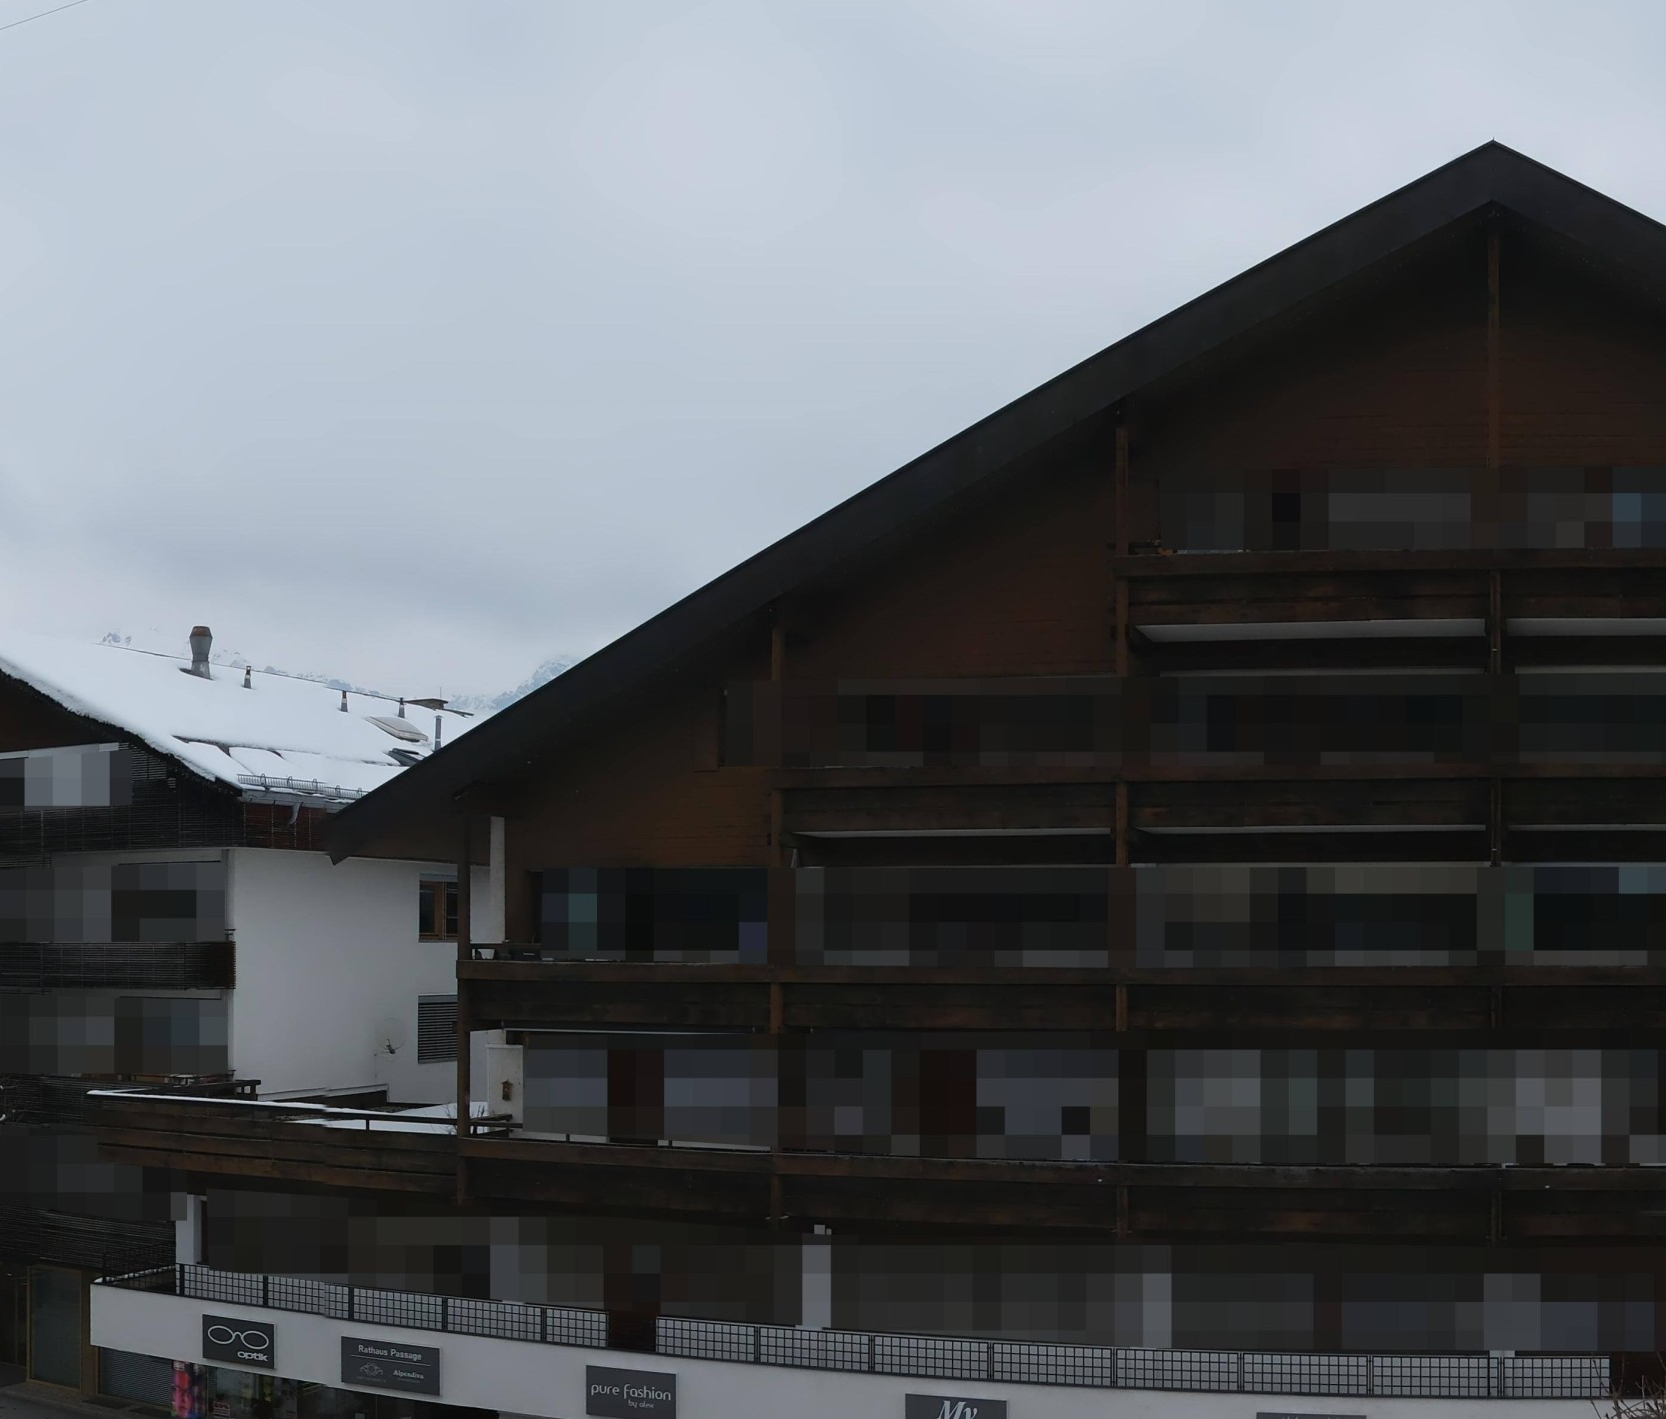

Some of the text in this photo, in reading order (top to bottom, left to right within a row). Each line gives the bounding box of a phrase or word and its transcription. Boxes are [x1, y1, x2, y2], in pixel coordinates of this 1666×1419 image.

[237, 1350, 269, 1362] optik
[358, 1344, 423, 1361] Rathaus Passage
[591, 1383, 672, 1401] pure fashion
